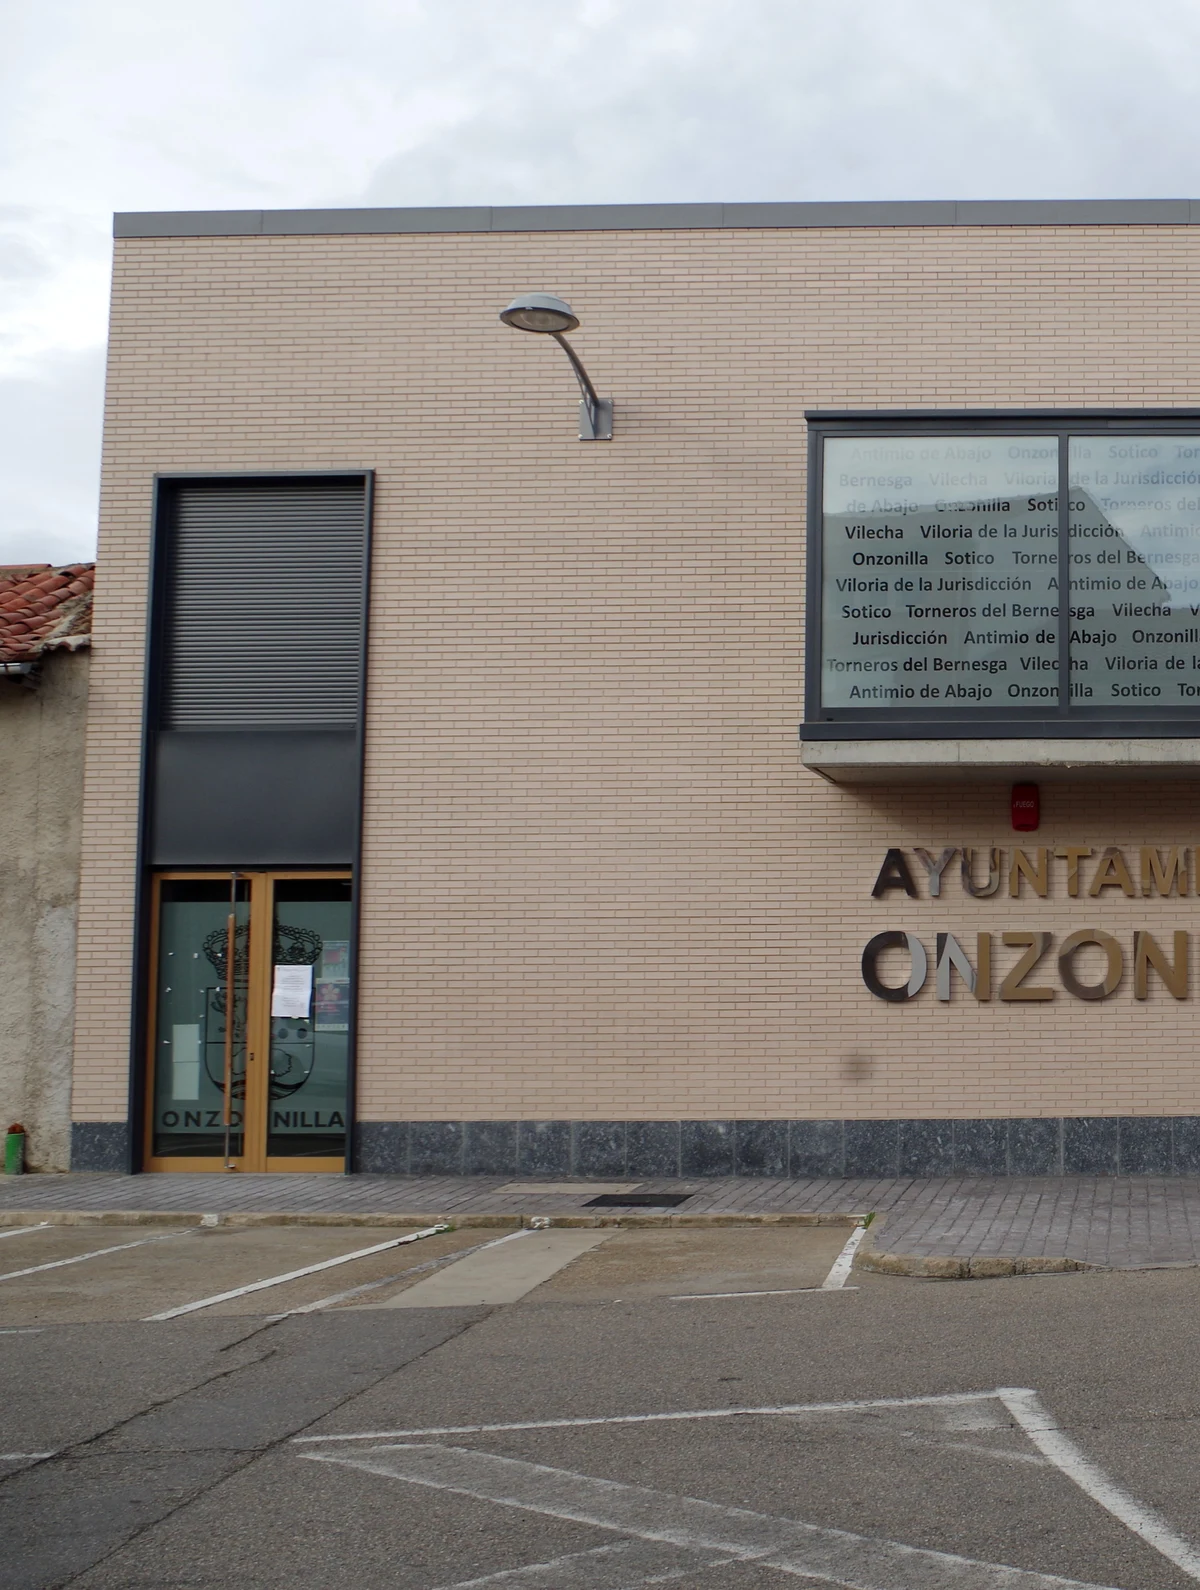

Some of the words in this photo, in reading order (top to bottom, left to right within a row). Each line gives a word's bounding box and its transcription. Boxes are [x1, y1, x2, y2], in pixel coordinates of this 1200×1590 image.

[839, 474, 912, 489] Bernesga
[928, 472, 988, 486] Vilecha
[1004, 472, 1056, 486] Viloria
[1069, 471, 1090, 485] de
[1095, 471, 1108, 485] la
[847, 499, 866, 513] de
[871, 499, 919, 515] Abajo
[935, 498, 1010, 513] Onzonilla
[1101, 498, 1172, 511] Torneros
[1176, 497, 1200, 511] del
[845, 525, 904, 539] Vilecha
[920, 525, 973, 539] Viloria
[978, 524, 998, 538] de
[1003, 524, 1017, 538] la
[1021, 523, 1125, 539] Jurisdicción
[852, 551, 928, 566] Onzonilla
[944, 551, 995, 565] Sotico
[1012, 551, 1091, 564] Torneros
[1096, 550, 1121, 564] del
[1126, 550, 1200, 567] Bernesga
[835, 578, 889, 593] Viloria
[893, 577, 914, 592] de
[919, 577, 932, 591] la
[937, 576, 1032, 593] Jurisdicción
[1047, 576, 1121, 591] Antimio
[1126, 576, 1146, 590] de
[1151, 576, 1199, 593] Abajo
[841, 605, 892, 619] Sotico
[906, 604, 977, 618] Torneros
[982, 603, 1006, 618] del
[1012, 603, 1095, 620] Bernesga
[1112, 603, 1171, 617] Vilecha
[852, 630, 947, 646] Jurisdicción
[964, 630, 1029, 645] Antimio
[1035, 629, 1055, 644] de
[1069, 630, 1117, 647] Abajo
[827, 658, 898, 673] Torneros
[903, 658, 927, 672] del
[933, 658, 1007, 675] Bernesga
[1019, 656, 1088, 671] Vilecha
[1105, 656, 1158, 670] Viloria
[1165, 655, 1185, 670] de
[850, 685, 914, 700] Antimio
[920, 684, 940, 699] de
[945, 684, 992, 701] Abajo
[1007, 683, 1093, 698] Onzonilla
[1111, 683, 1161, 698] Sotico
